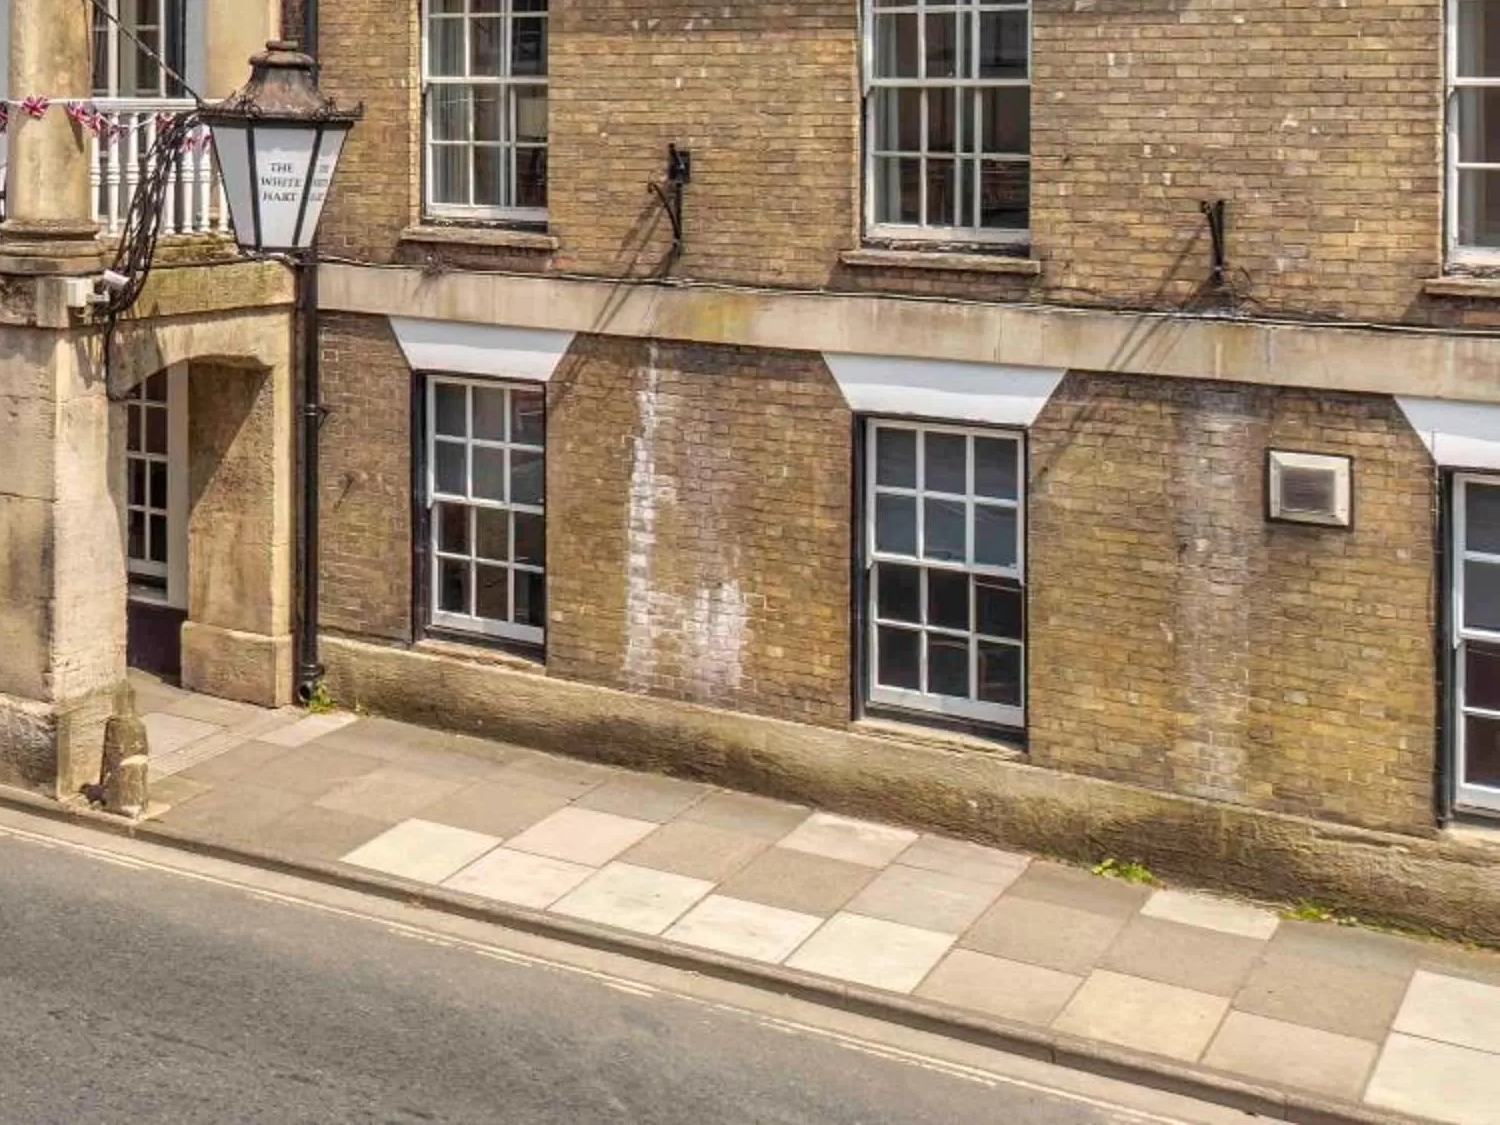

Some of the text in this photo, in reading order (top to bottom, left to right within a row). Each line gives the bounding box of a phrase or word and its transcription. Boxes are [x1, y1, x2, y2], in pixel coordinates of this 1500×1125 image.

[268, 162, 293, 173] THE
[261, 176, 302, 188] WHITE
[262, 190, 298, 202] HART
